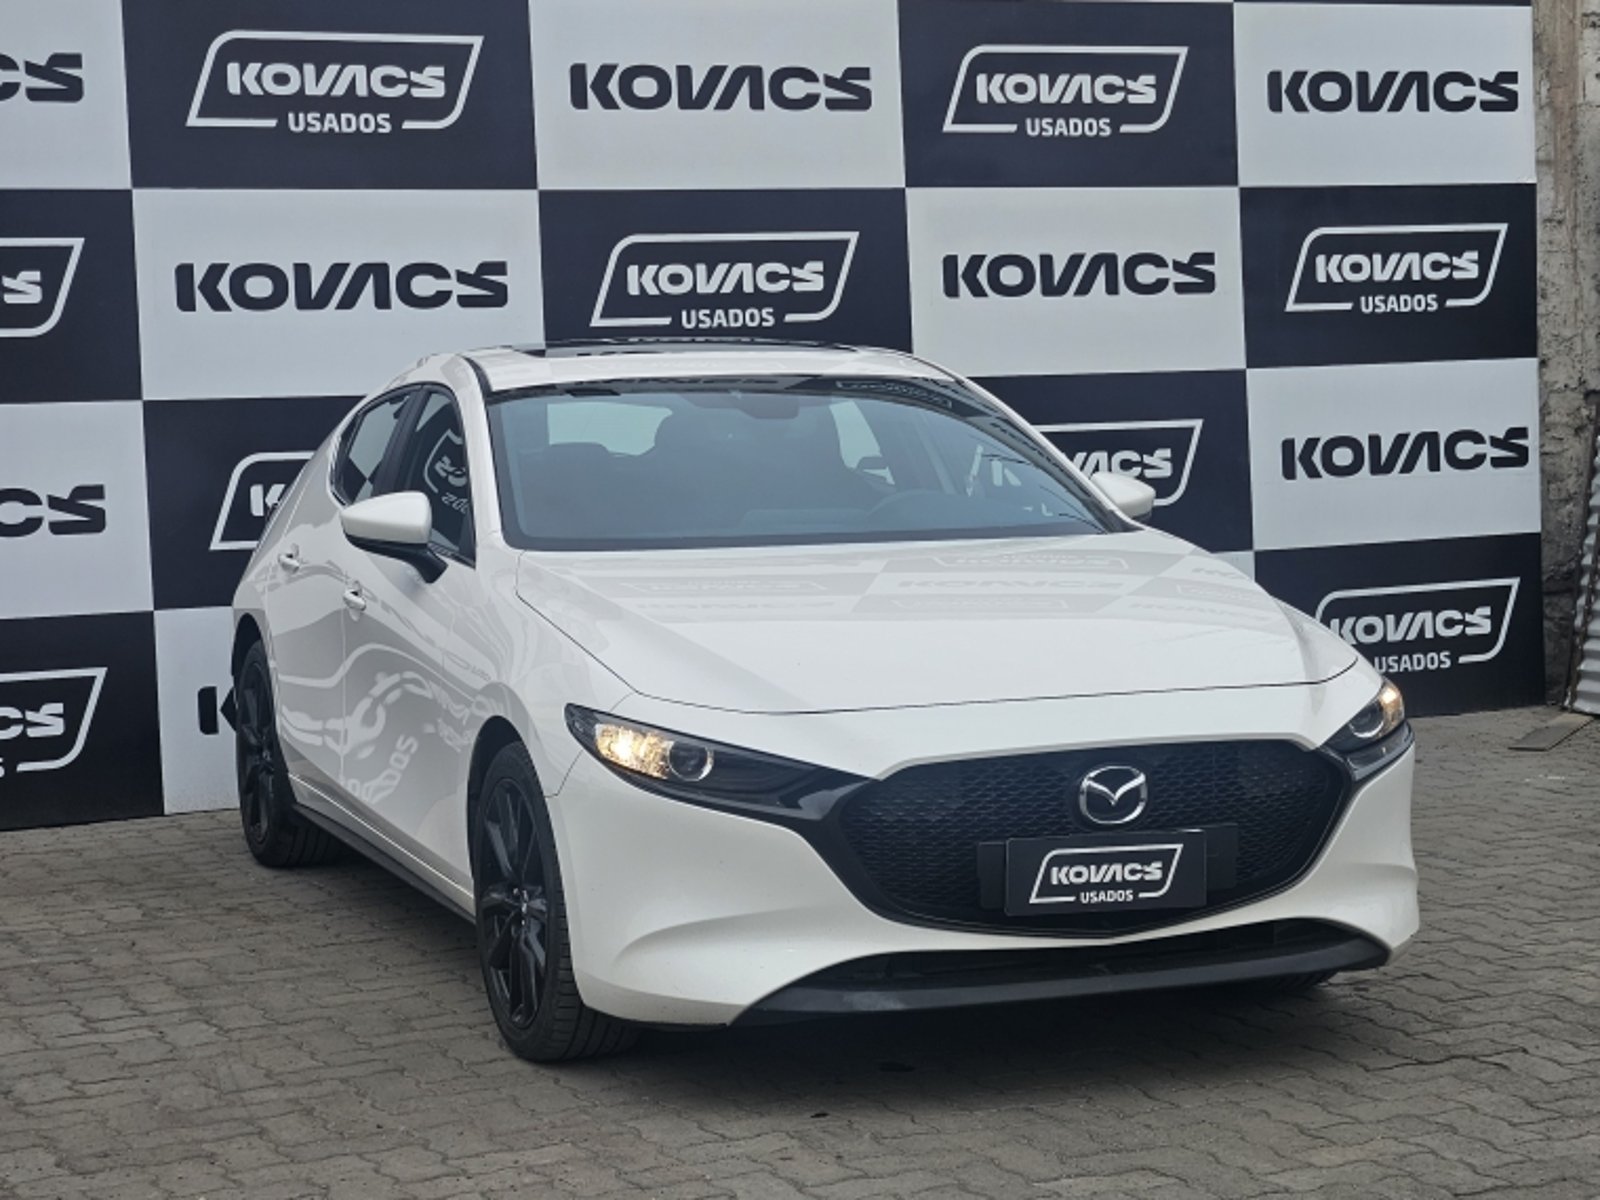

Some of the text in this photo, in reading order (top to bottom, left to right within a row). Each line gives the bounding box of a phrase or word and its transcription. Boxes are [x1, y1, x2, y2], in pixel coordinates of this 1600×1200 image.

[227, 62, 445, 98] KOVACS
[569, 62, 872, 112] KOVACS
[976, 73, 1156, 104] KOVACS
[1267, 70, 1518, 113] KOVACS
[287, 112, 392, 134] USADOS
[1025, 117, 1111, 137] USADOS
[626, 260, 824, 296] KOVACS
[942, 251, 1215, 299] KOVACS
[1315, 250, 1479, 283] KOVACS
[175, 260, 509, 312] KOVACS
[681, 308, 775, 329] USADOS
[1360, 294, 1438, 314] USADOS
[1281, 426, 1529, 481] KOVACS
[1329, 605, 1492, 645] KOVACS
[1374, 651, 1451, 675] USADOS
[1051, 861, 1163, 886] KOVACS
[1080, 889, 1134, 904] USADOS
